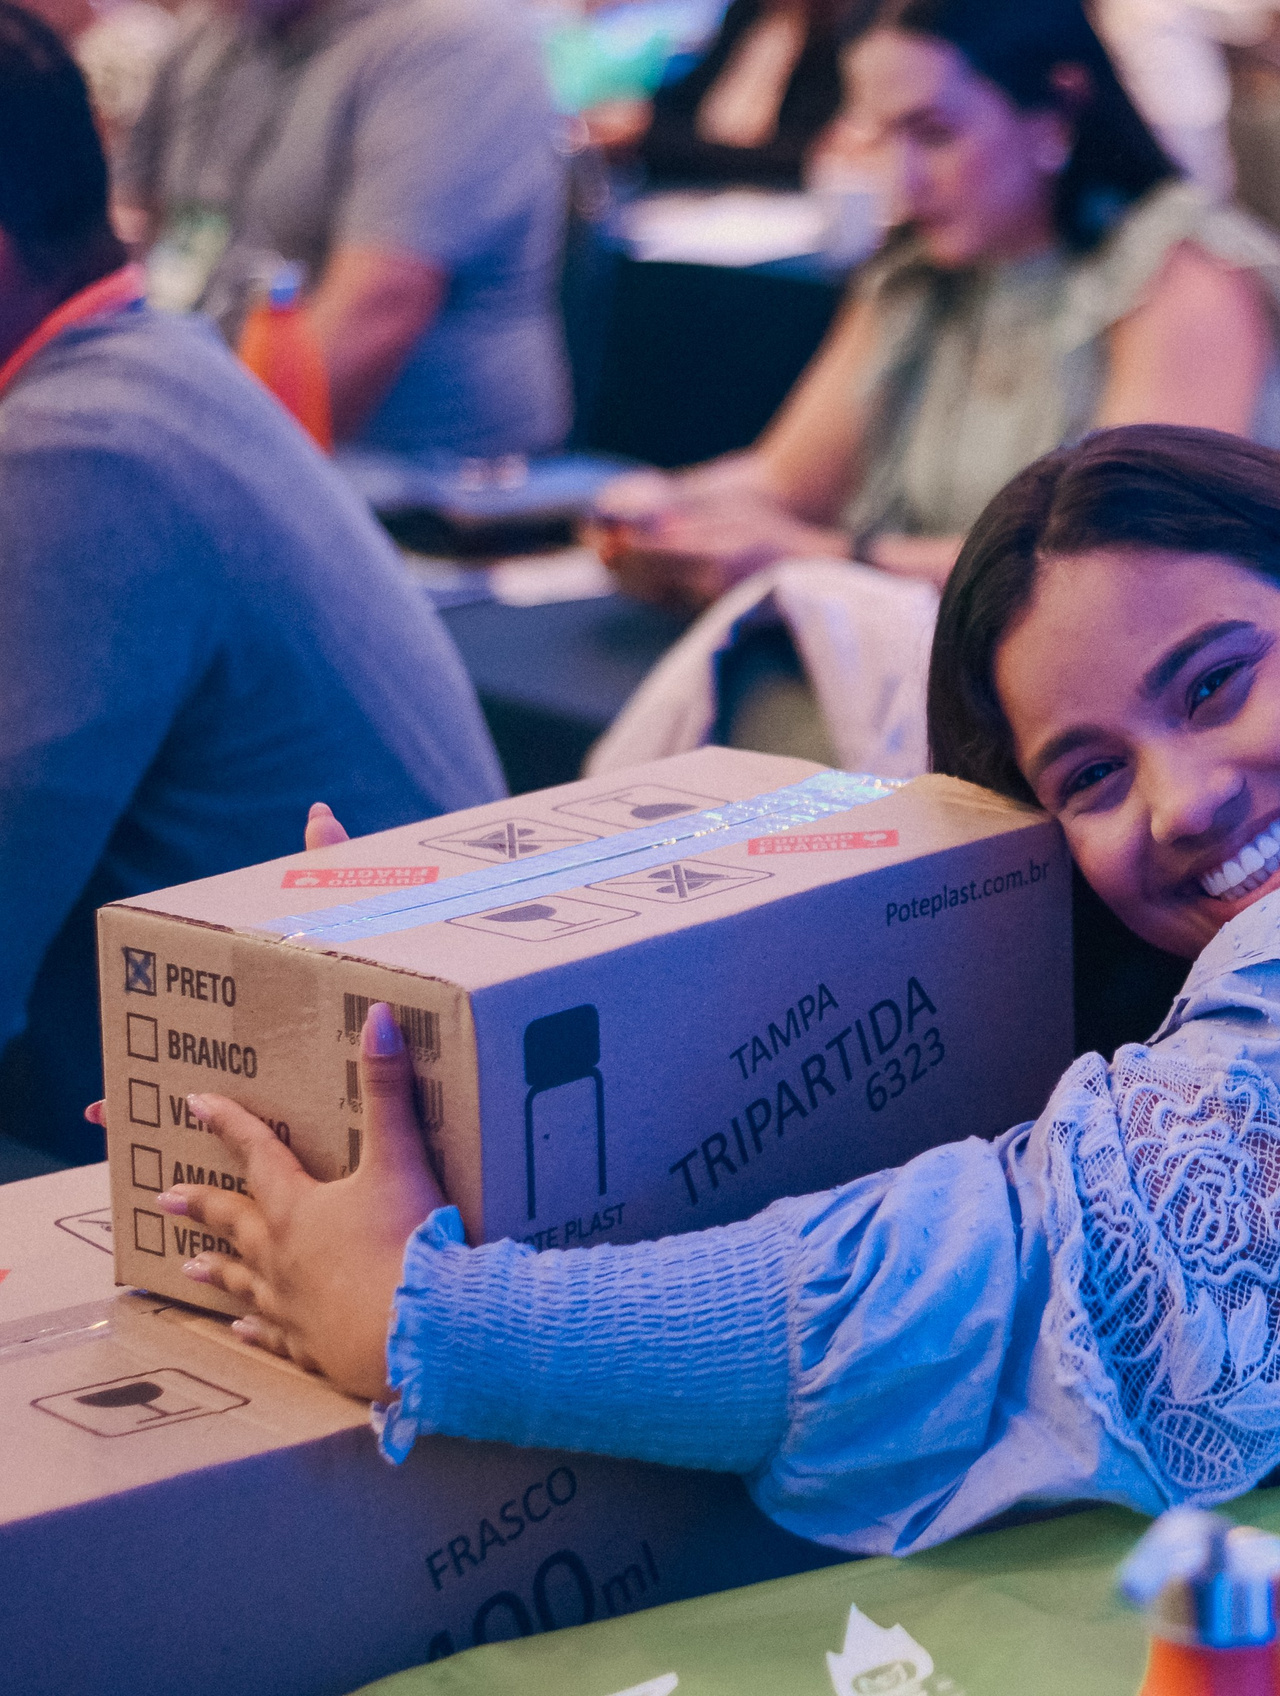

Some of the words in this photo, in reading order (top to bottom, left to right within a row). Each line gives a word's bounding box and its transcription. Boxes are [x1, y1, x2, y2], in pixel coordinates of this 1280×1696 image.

[886, 859, 1050, 926] Poteplast.com.br
[166, 963, 236, 1007] PRETO
[168, 1029, 257, 1078] BRANCO
[730, 983, 839, 1080] TAMPA
[669, 976, 937, 1206] TRIPARTIDA
[865, 1027, 945, 1113] 6323
[172, 1160, 254, 1198] AMARE
[173, 1225, 243, 1259] VERD
[516, 1226, 560, 1253] TE
[564, 1202, 626, 1244] PLAST
[425, 1465, 577, 1591] FRASCO
